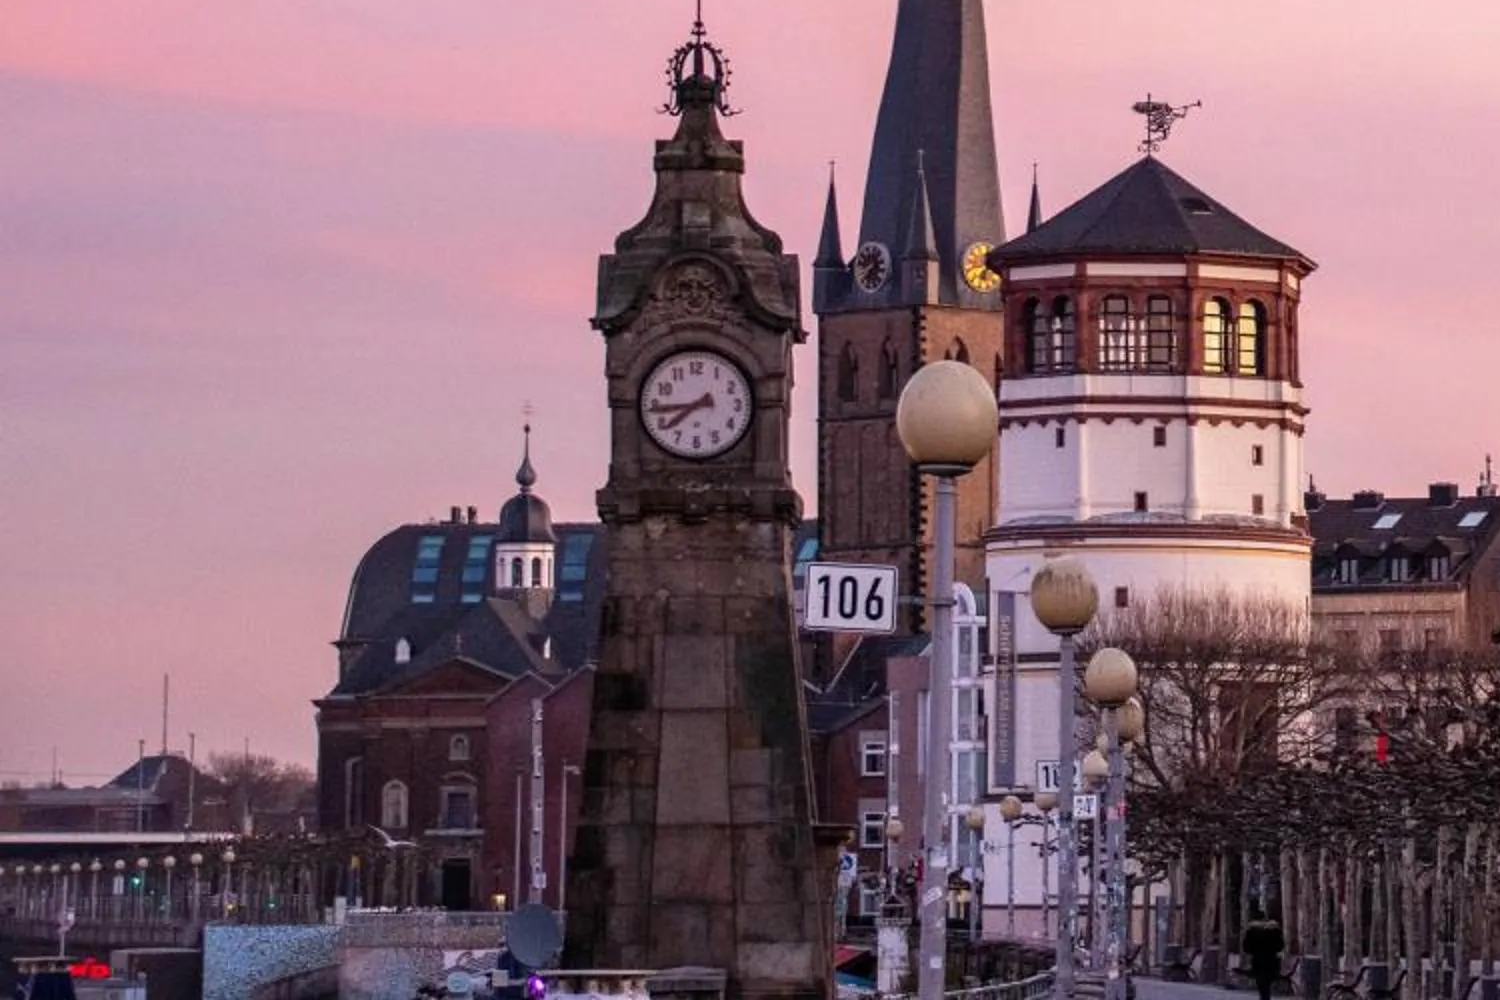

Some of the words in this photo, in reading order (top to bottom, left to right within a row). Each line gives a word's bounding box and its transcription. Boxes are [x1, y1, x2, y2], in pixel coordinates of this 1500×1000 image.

[672, 366, 684, 381] 11
[690, 361, 704, 376] 12
[714, 365, 719, 380] 1
[658, 382, 673, 396] 10
[727, 380, 735, 395] 2
[733, 398, 742, 413] 3
[726, 417, 734, 431] 4
[674, 430, 682, 445] 7
[818, 575, 884, 621] 106
